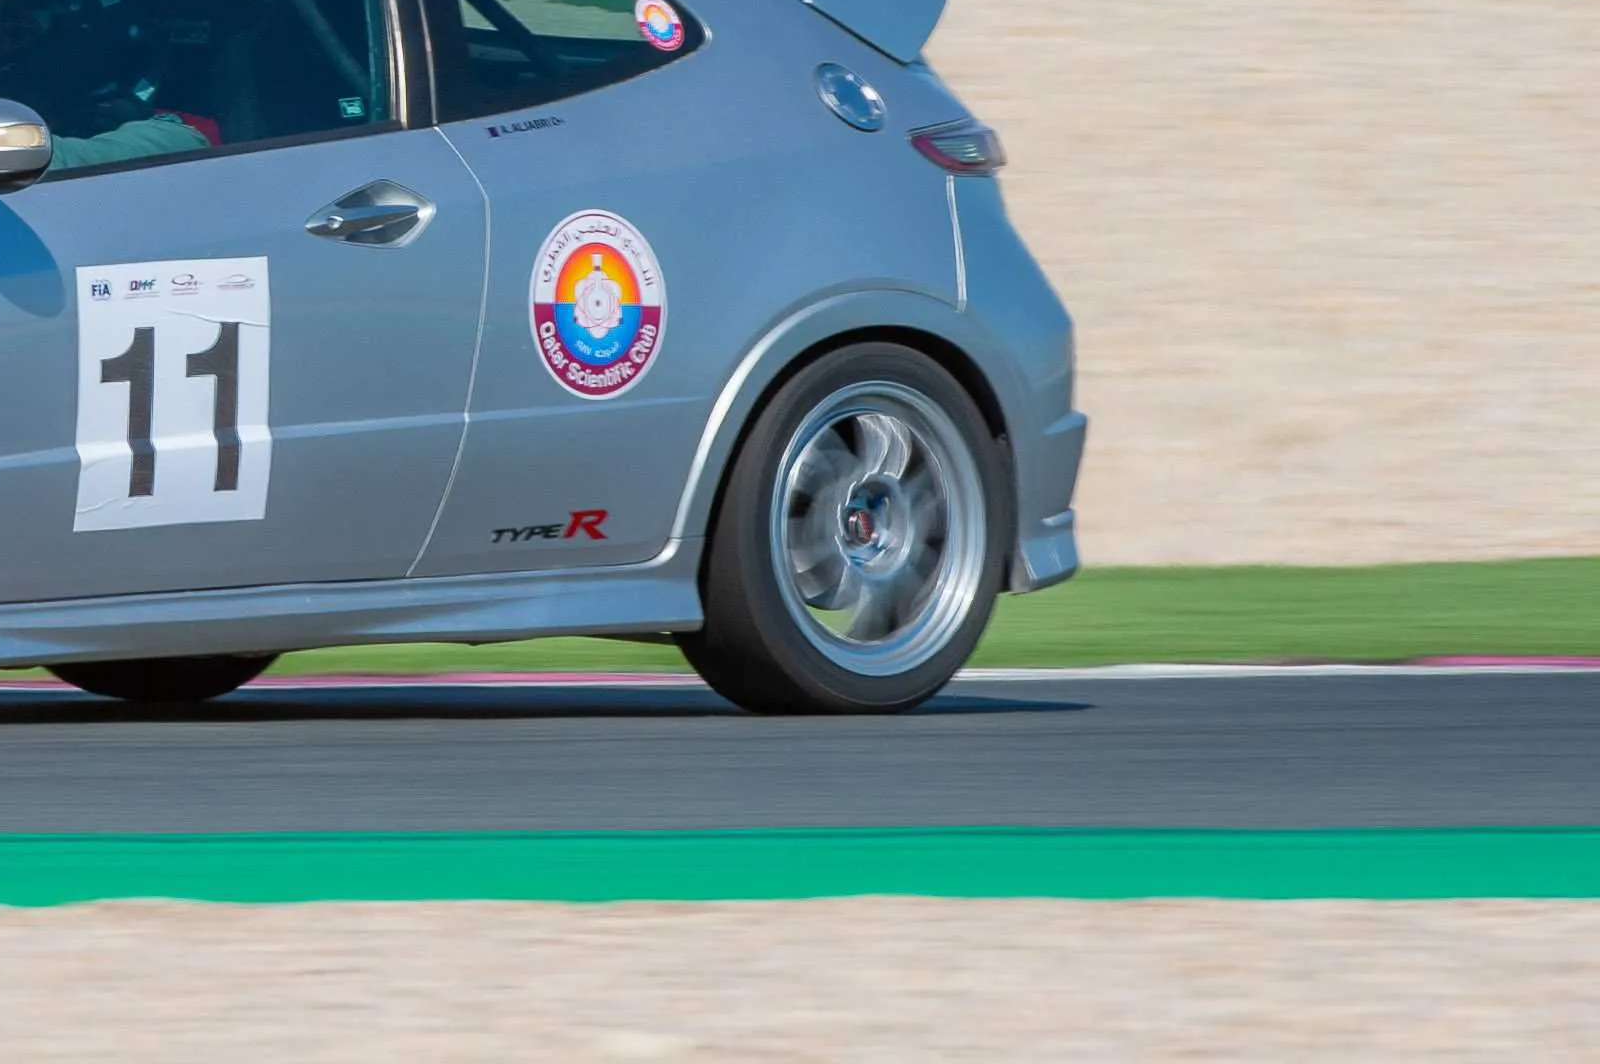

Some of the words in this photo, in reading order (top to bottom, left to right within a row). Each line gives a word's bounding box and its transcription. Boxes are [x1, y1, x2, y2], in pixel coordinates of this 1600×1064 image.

[539, 321, 570, 369] Qatar
[628, 323, 658, 365] Club
[99, 322, 240, 497] 11
